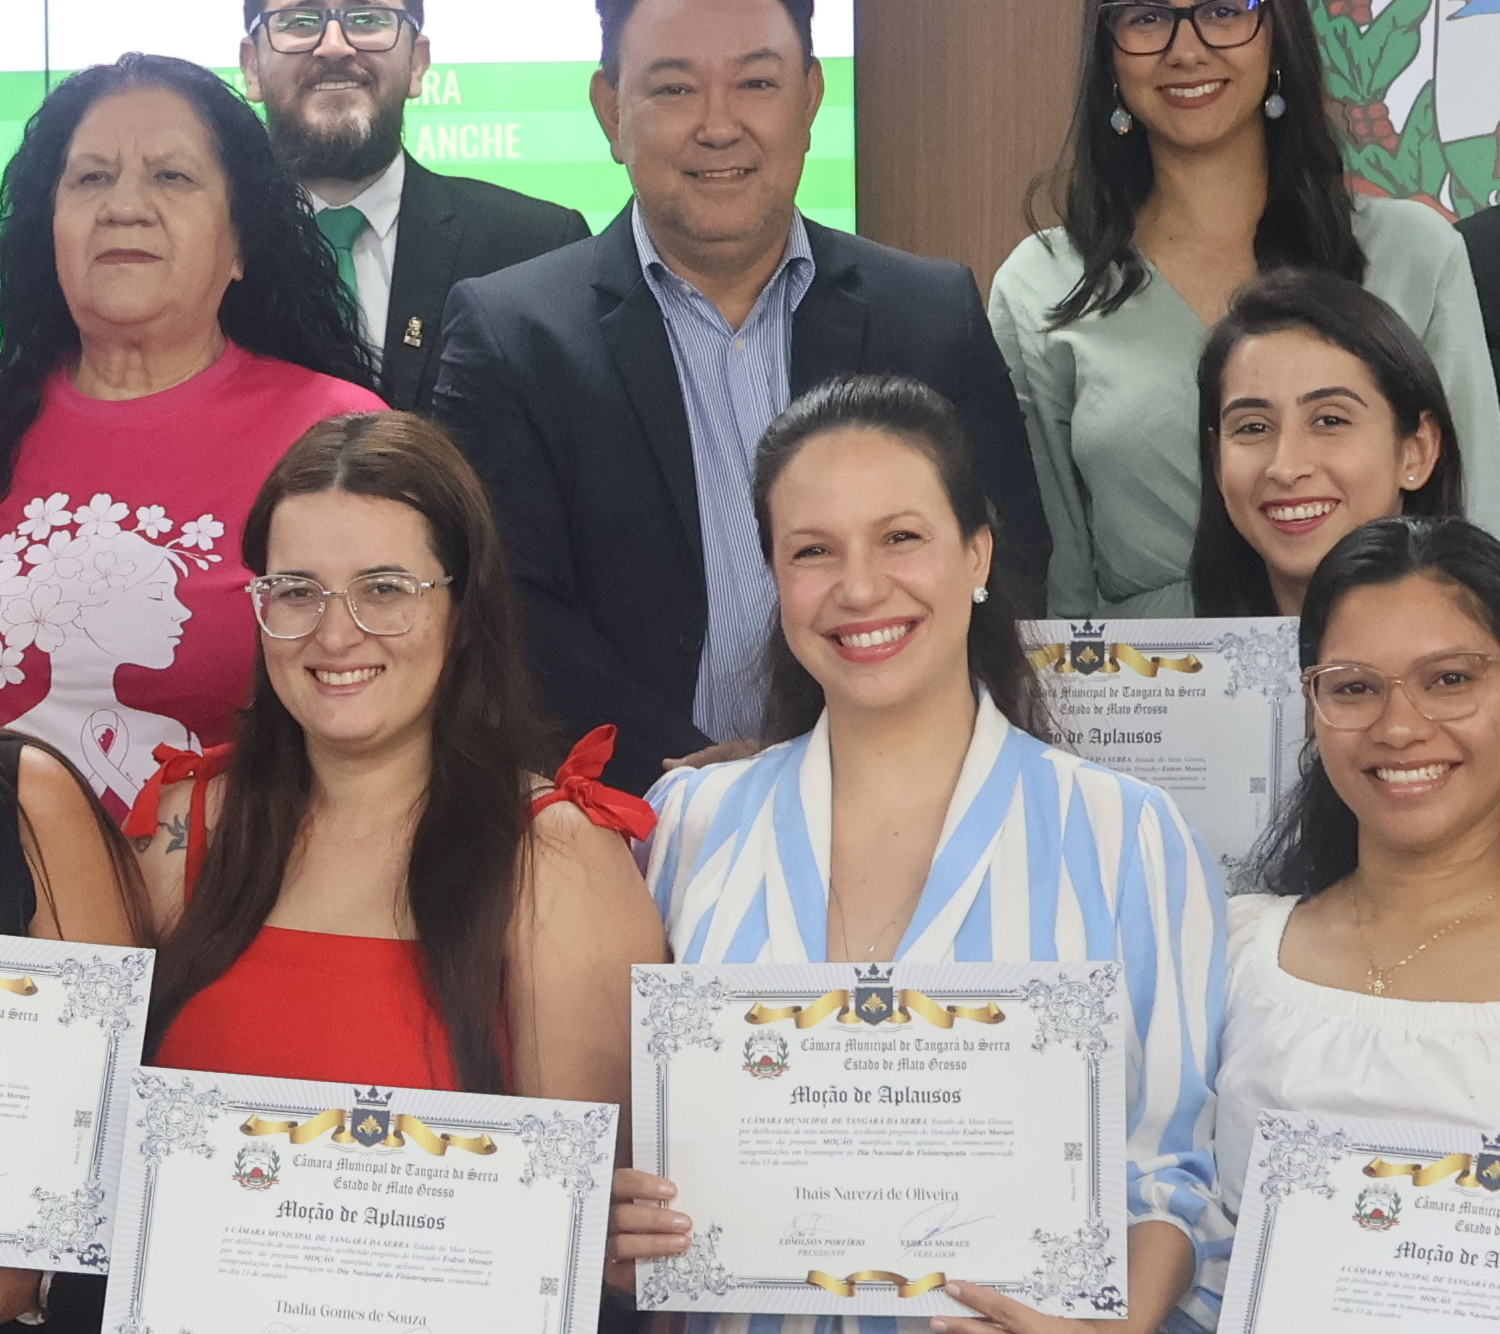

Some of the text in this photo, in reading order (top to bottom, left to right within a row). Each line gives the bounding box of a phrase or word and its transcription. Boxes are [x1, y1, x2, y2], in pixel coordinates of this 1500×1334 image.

[1089, 728, 1162, 746] Aplausos
[790, 1085, 961, 1107] Moção de Aplausos
[887, 1188, 902, 1200] de
[906, 1188, 958, 1202] Oliveira
[276, 1200, 445, 1230] Moção de Aplausos
[1394, 1241, 1453, 1265] Moção
[1460, 1248, 1478, 1266] de
[320, 1305, 365, 1319] Gomes
[369, 1309, 383, 1322] de
[388, 1311, 426, 1325] Souza
